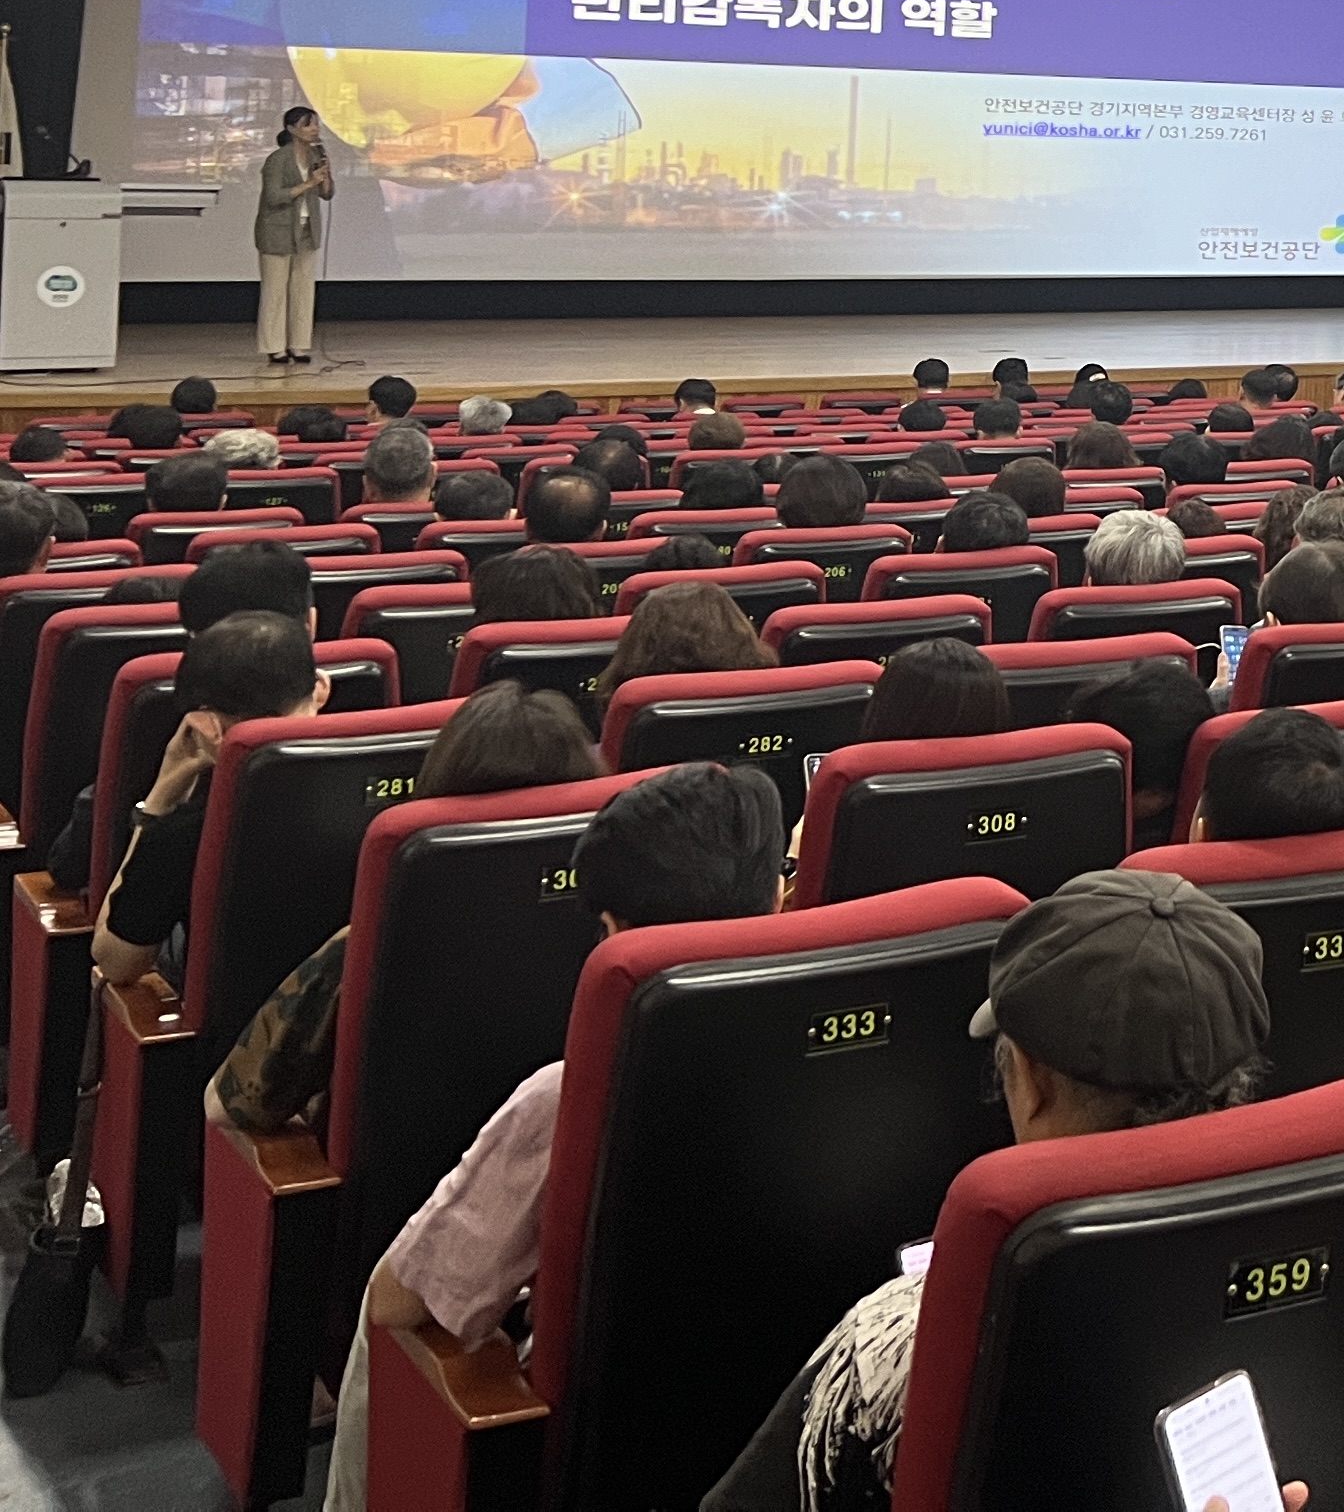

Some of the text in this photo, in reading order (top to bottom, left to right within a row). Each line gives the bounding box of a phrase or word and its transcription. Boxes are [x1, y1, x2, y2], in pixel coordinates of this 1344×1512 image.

[984, 98, 1083, 116] 안전보건공단
[1090, 101, 1184, 119] 경기지역본부
[1190, 105, 1295, 123] 경영교육센터장
[1301, 109, 1315, 124] 성
[1320, 109, 1335, 124] 윤
[983, 122, 1141, 140] yunici@kosha.or.kr
[1159, 125, 1267, 142] 031.259.7261
[1198, 241, 1321, 261] 안전보건공단
[824, 566, 846, 578] 206
[748, 735, 783, 753] 282
[376, 777, 414, 797] 281
[977, 812, 1016, 835] 308
[822, 1010, 875, 1042] 333
[1246, 1257, 1310, 1302] 359
